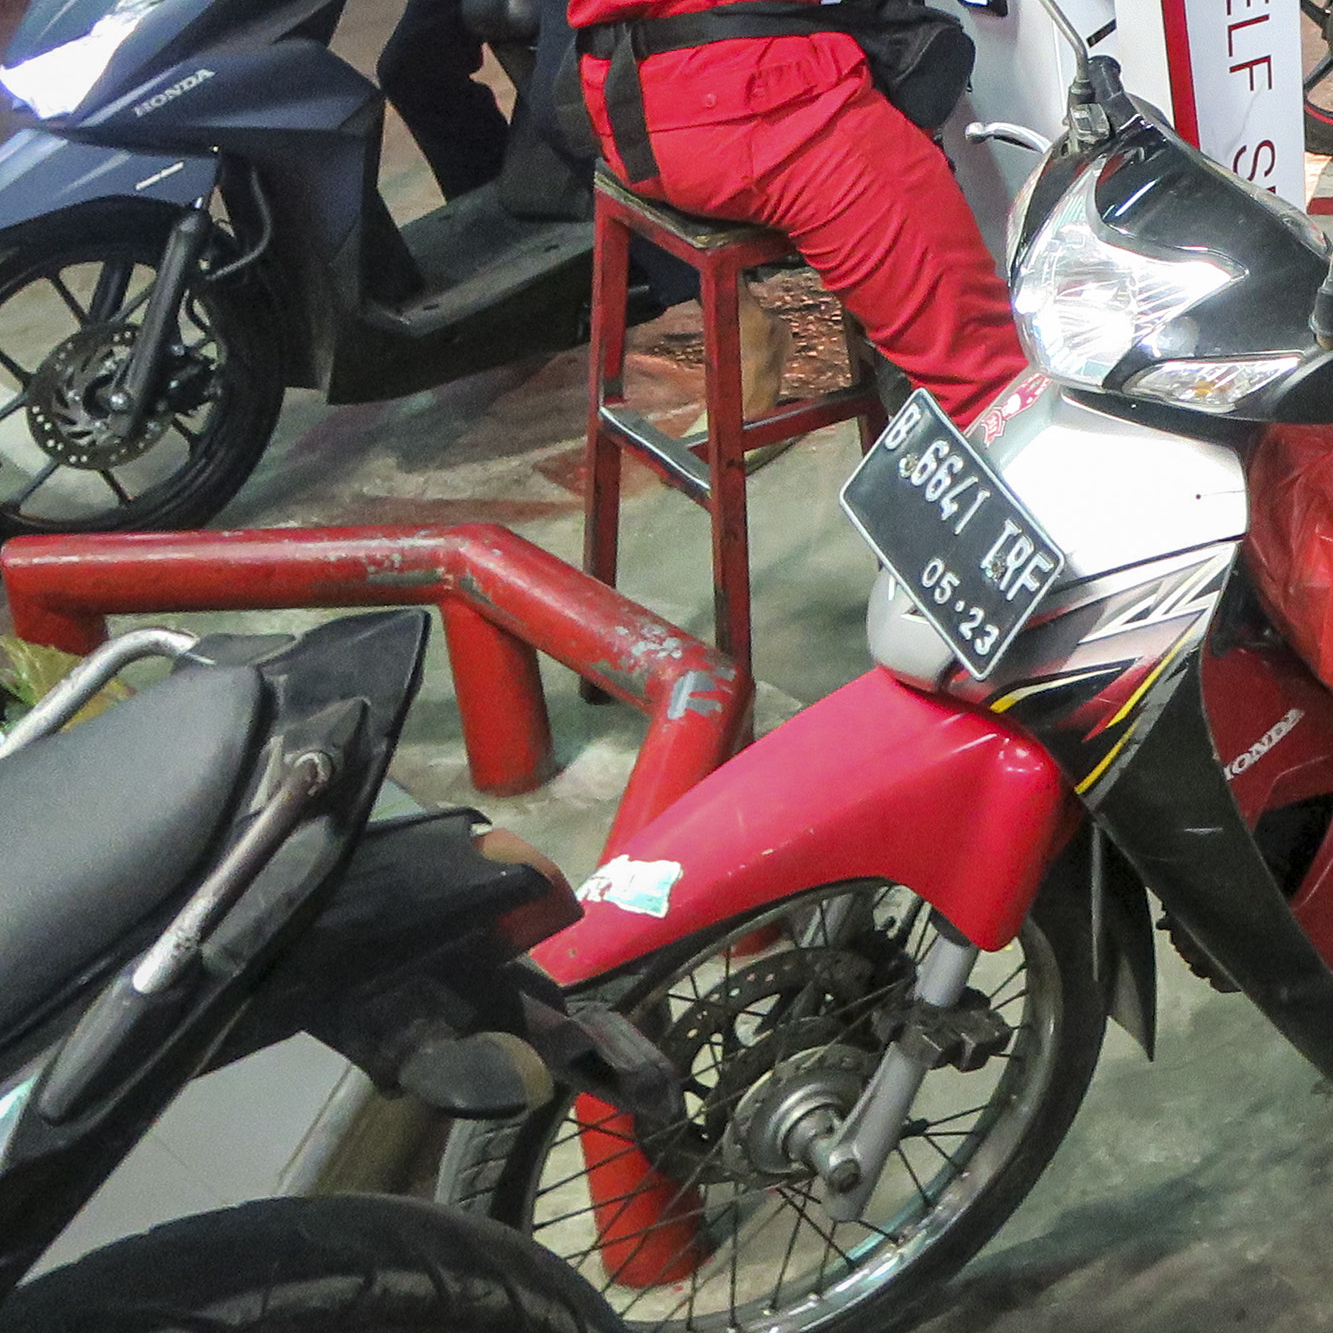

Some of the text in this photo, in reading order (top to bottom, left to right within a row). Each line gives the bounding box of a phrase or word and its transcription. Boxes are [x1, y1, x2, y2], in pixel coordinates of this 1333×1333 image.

[134, 69, 216, 118] HONDA
[884, 403, 922, 450] B
[910, 439, 992, 536] 6641
